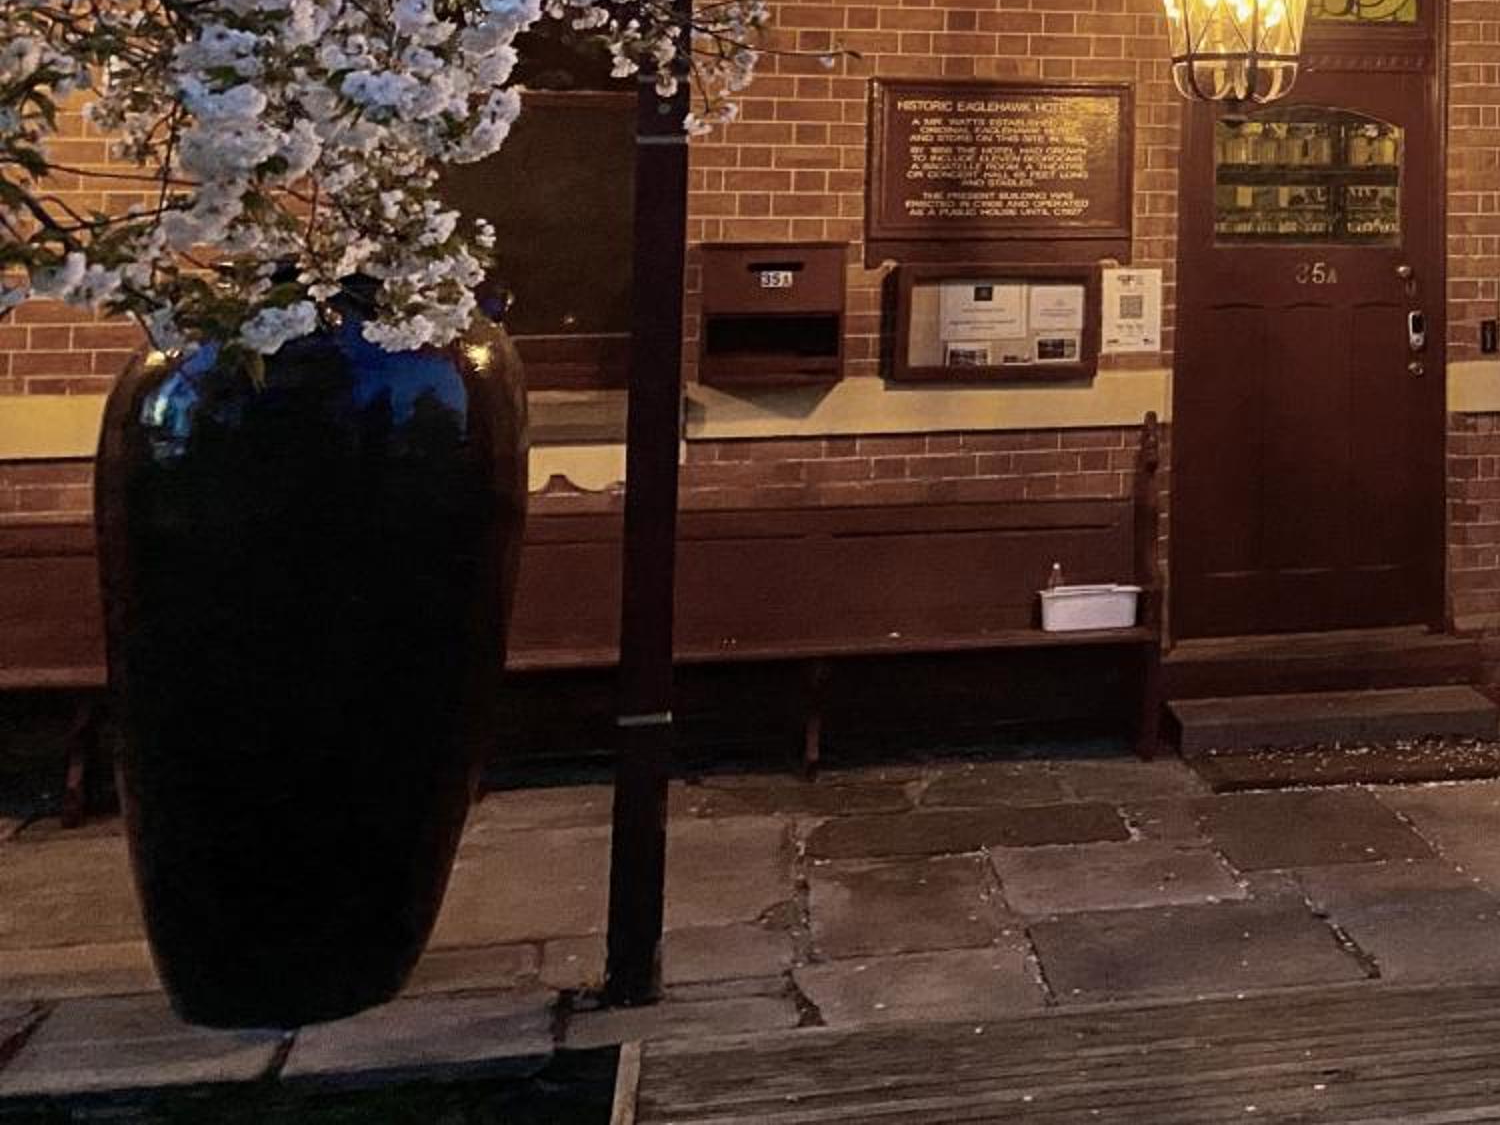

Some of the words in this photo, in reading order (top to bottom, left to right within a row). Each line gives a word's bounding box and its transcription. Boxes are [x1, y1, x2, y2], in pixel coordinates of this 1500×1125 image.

[897, 101, 953, 112] HISTORIC
[957, 101, 1031, 112] EAGLEHAWK
[1295, 262, 1338, 284] 35A
